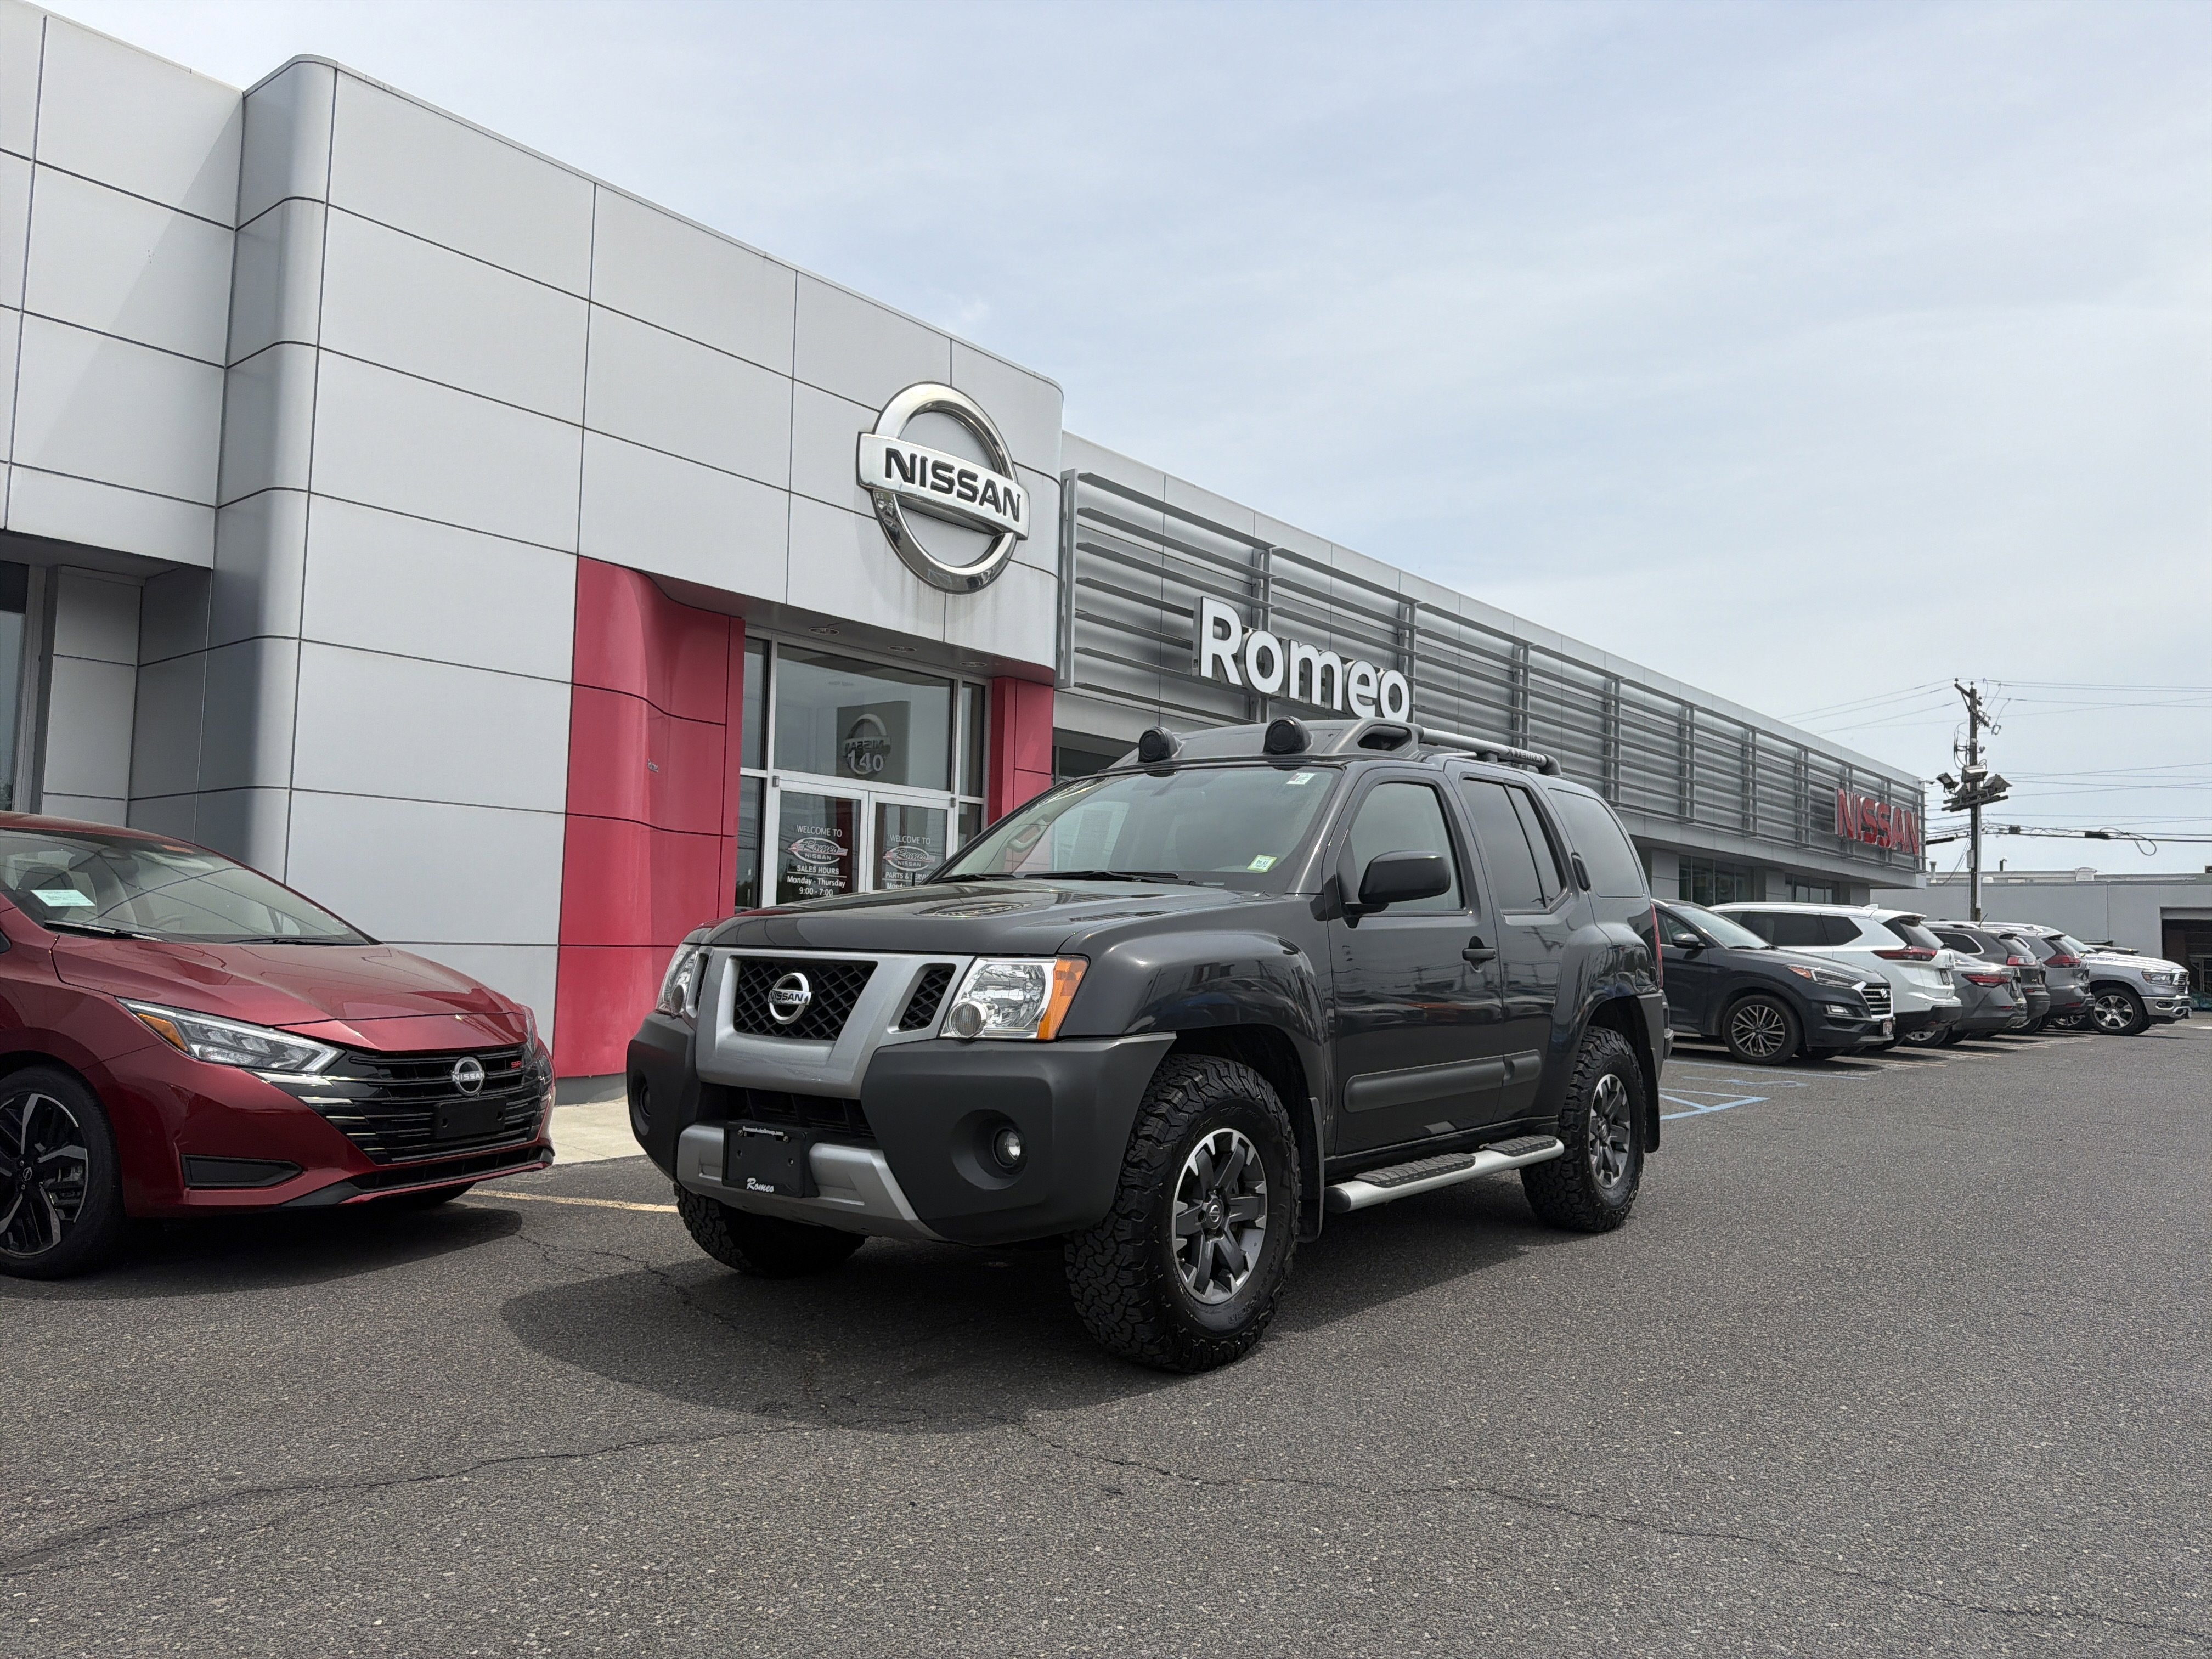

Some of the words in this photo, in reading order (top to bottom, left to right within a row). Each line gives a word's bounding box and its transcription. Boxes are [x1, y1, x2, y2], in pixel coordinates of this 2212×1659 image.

[884, 447, 1021, 523] NISSAN
[1198, 596, 1410, 723] Romeo
[848, 750, 884, 772] 140
[1836, 788, 1919, 856] NISSAN
[797, 825, 831, 836] WELCOME
[832, 828, 843, 837] TO
[802, 838, 839, 853] Romeo
[890, 834, 921, 844] WELCOME
[922, 837, 931, 845] TO
[895, 847, 927, 860] Romeo
[797, 865, 816, 873] SALES
[818, 867, 839, 875] HOURS
[787, 875, 812, 885] Monday
[817, 878, 846, 888] Thursday
[819, 888, 833, 897] 7:00
[769, 991, 804, 1002] NISSAN
[452, 1071, 485, 1082] NISSAN
[742, 1126, 784, 1136] RomeoAutoGroup.com
[746, 1177, 775, 1193] Romeo
